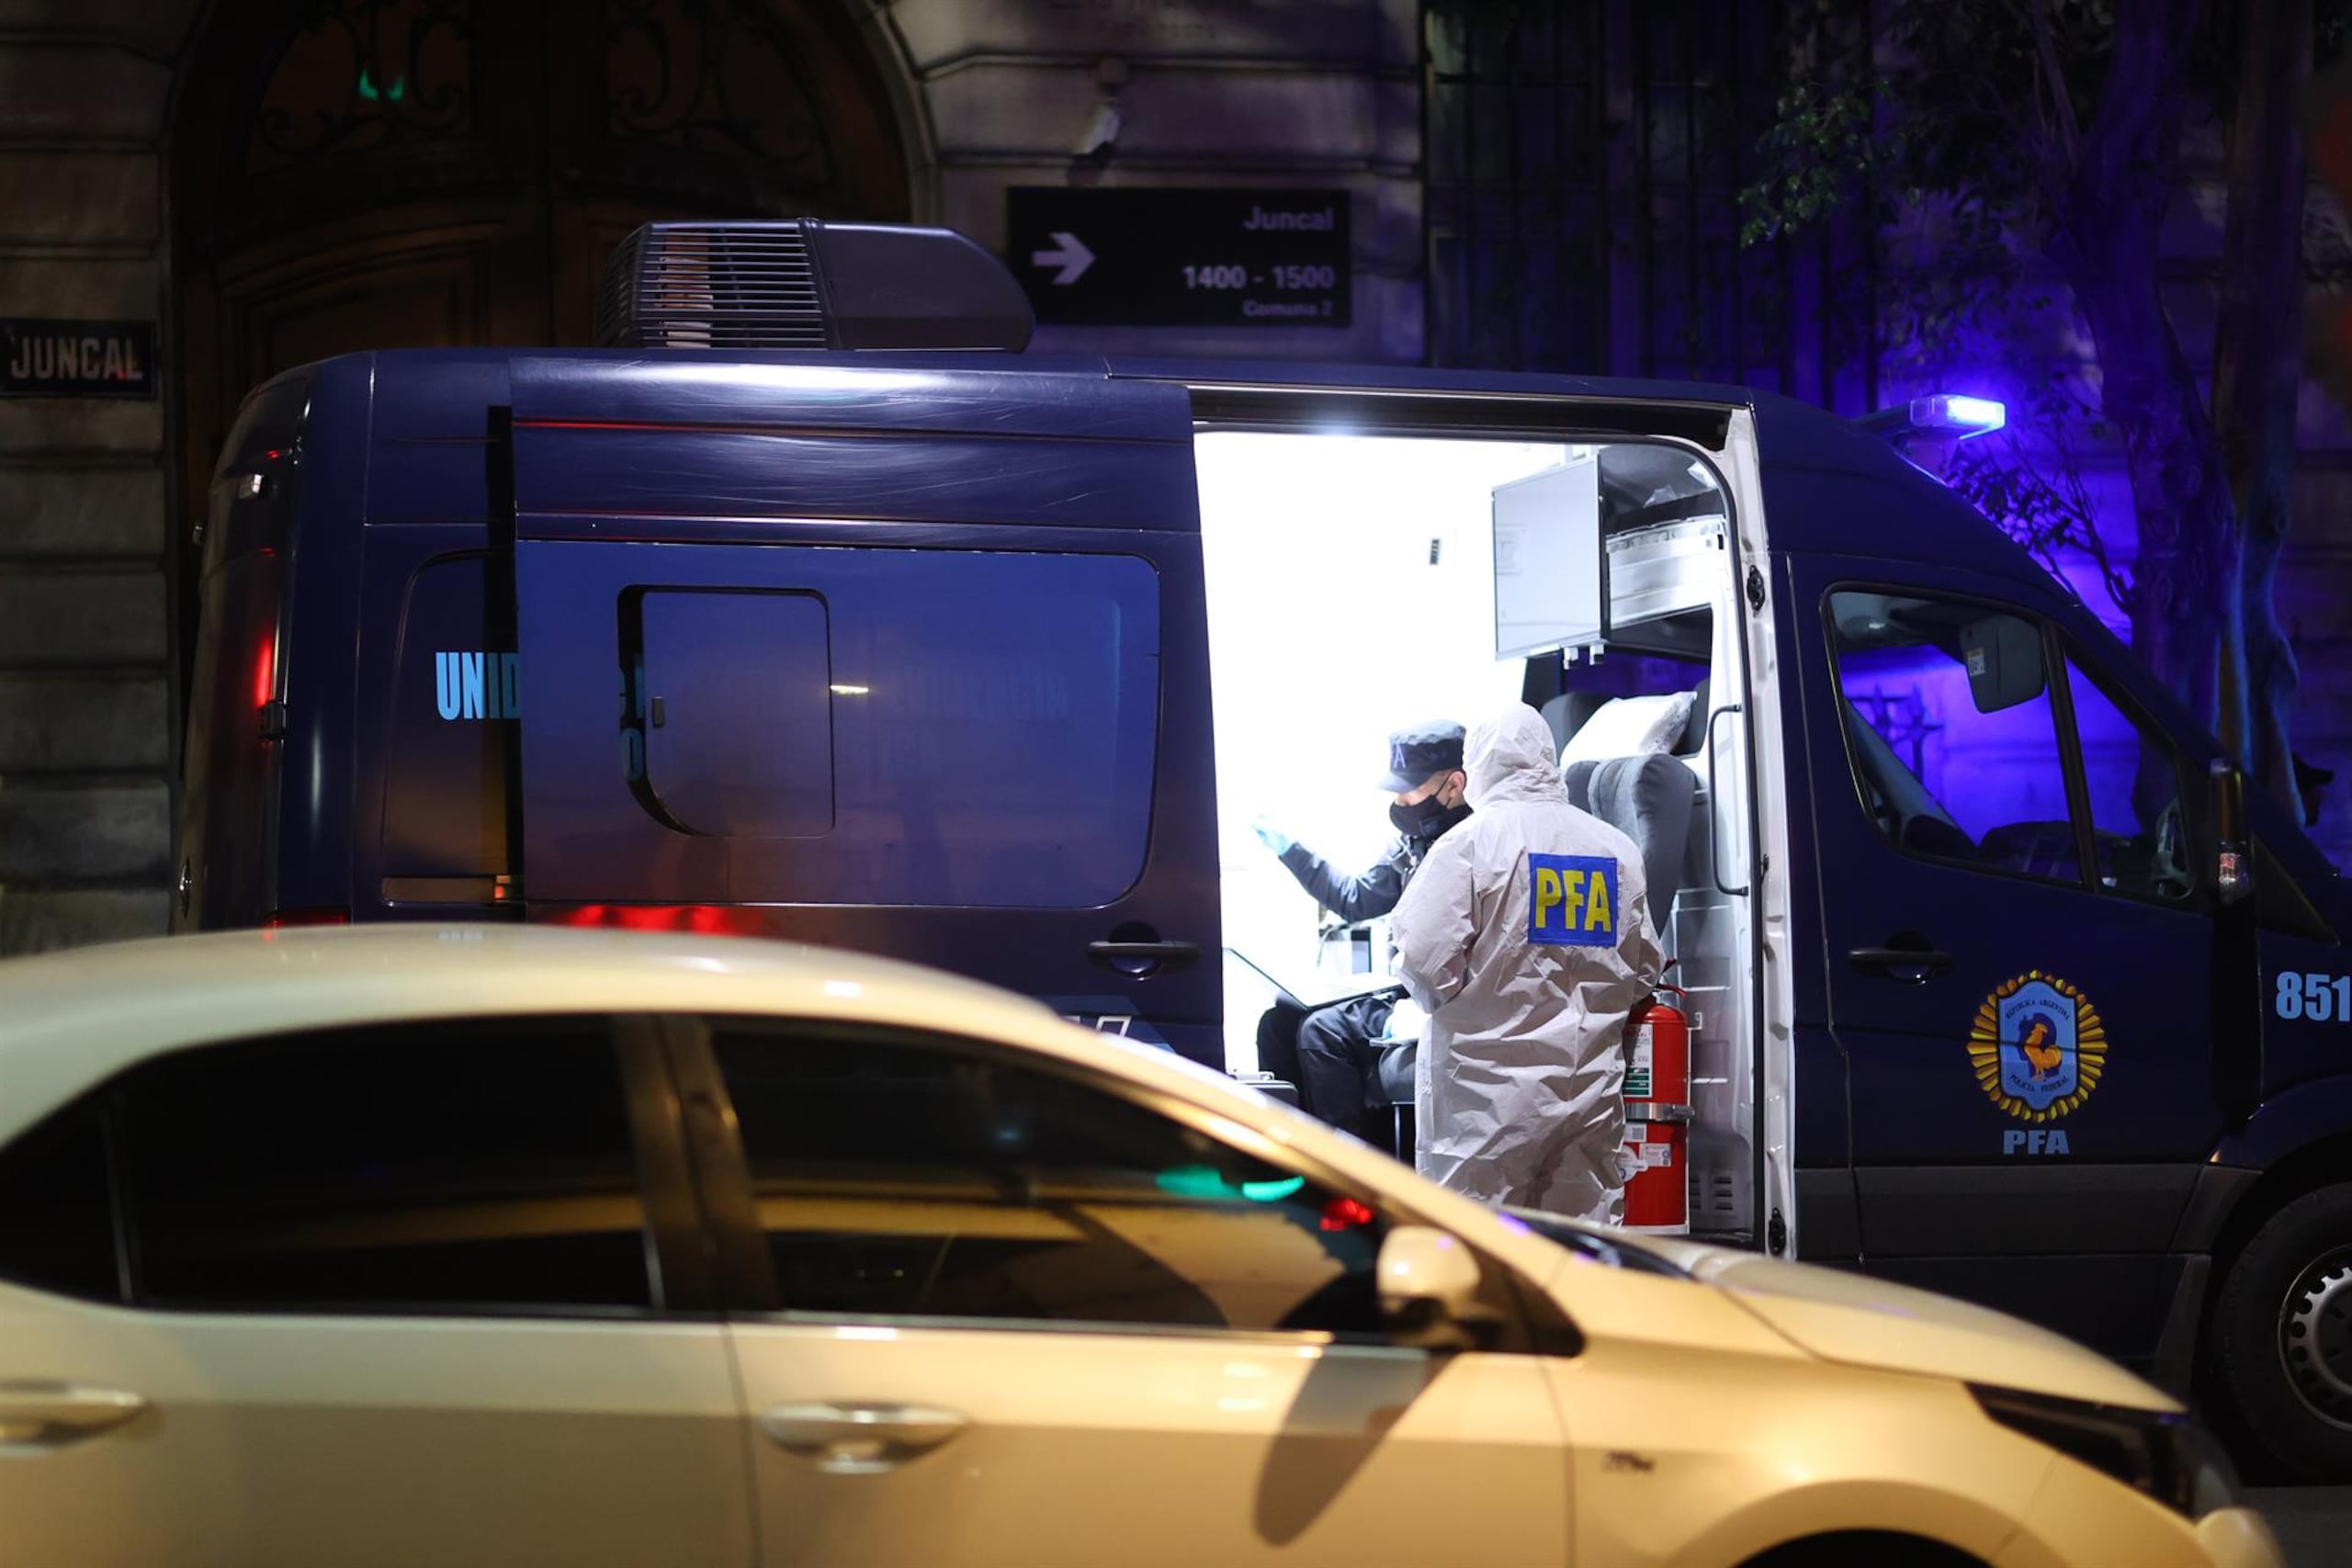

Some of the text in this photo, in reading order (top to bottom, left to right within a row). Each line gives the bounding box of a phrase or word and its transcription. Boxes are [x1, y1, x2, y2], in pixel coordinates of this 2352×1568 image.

[1243, 205, 1334, 231] Juncal
[1182, 265, 1247, 289] 1400
[1272, 265, 1335, 289] 1500
[1242, 299, 1319, 317] Comuna
[11, 336, 143, 379] JUNCAL
[1535, 867, 1611, 932] PFA
[2040, 998, 2070, 1020] ARGENTINA
[2275, 971, 2351, 1022] 851
[2002, 1129, 2070, 1156] PFA
